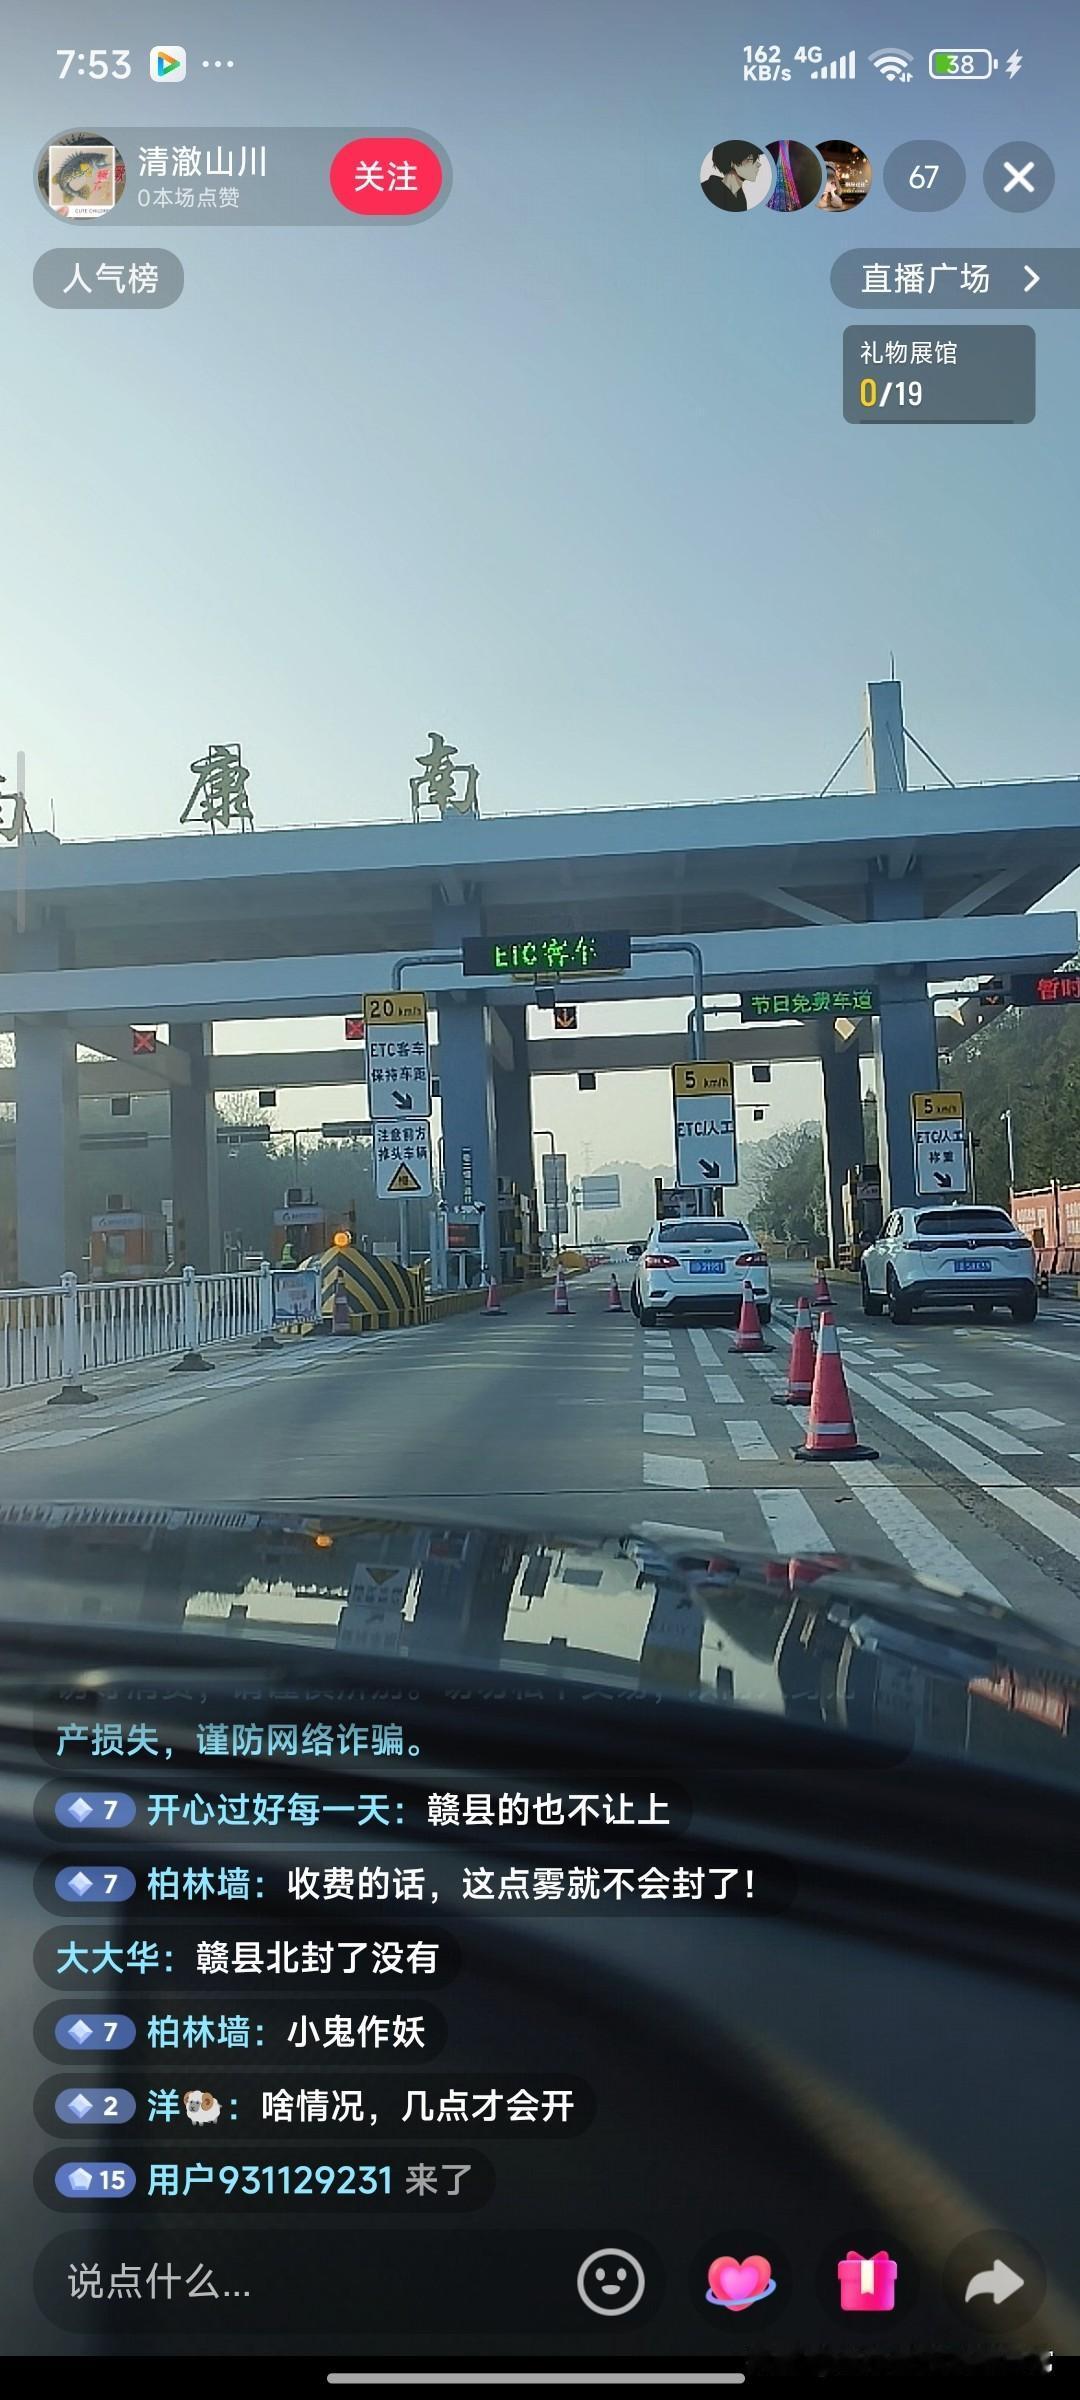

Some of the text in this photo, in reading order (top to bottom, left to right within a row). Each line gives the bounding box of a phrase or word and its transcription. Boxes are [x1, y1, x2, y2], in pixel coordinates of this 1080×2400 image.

[370, 1000, 394, 1018] 20
[751, 988, 873, 1015] 节日免费车道
[370, 1041, 425, 1058] ETC客车
[371, 1065, 427, 1082] 保持车距
[685, 1071, 696, 1089] 5
[924, 1099, 933, 1114] 5
